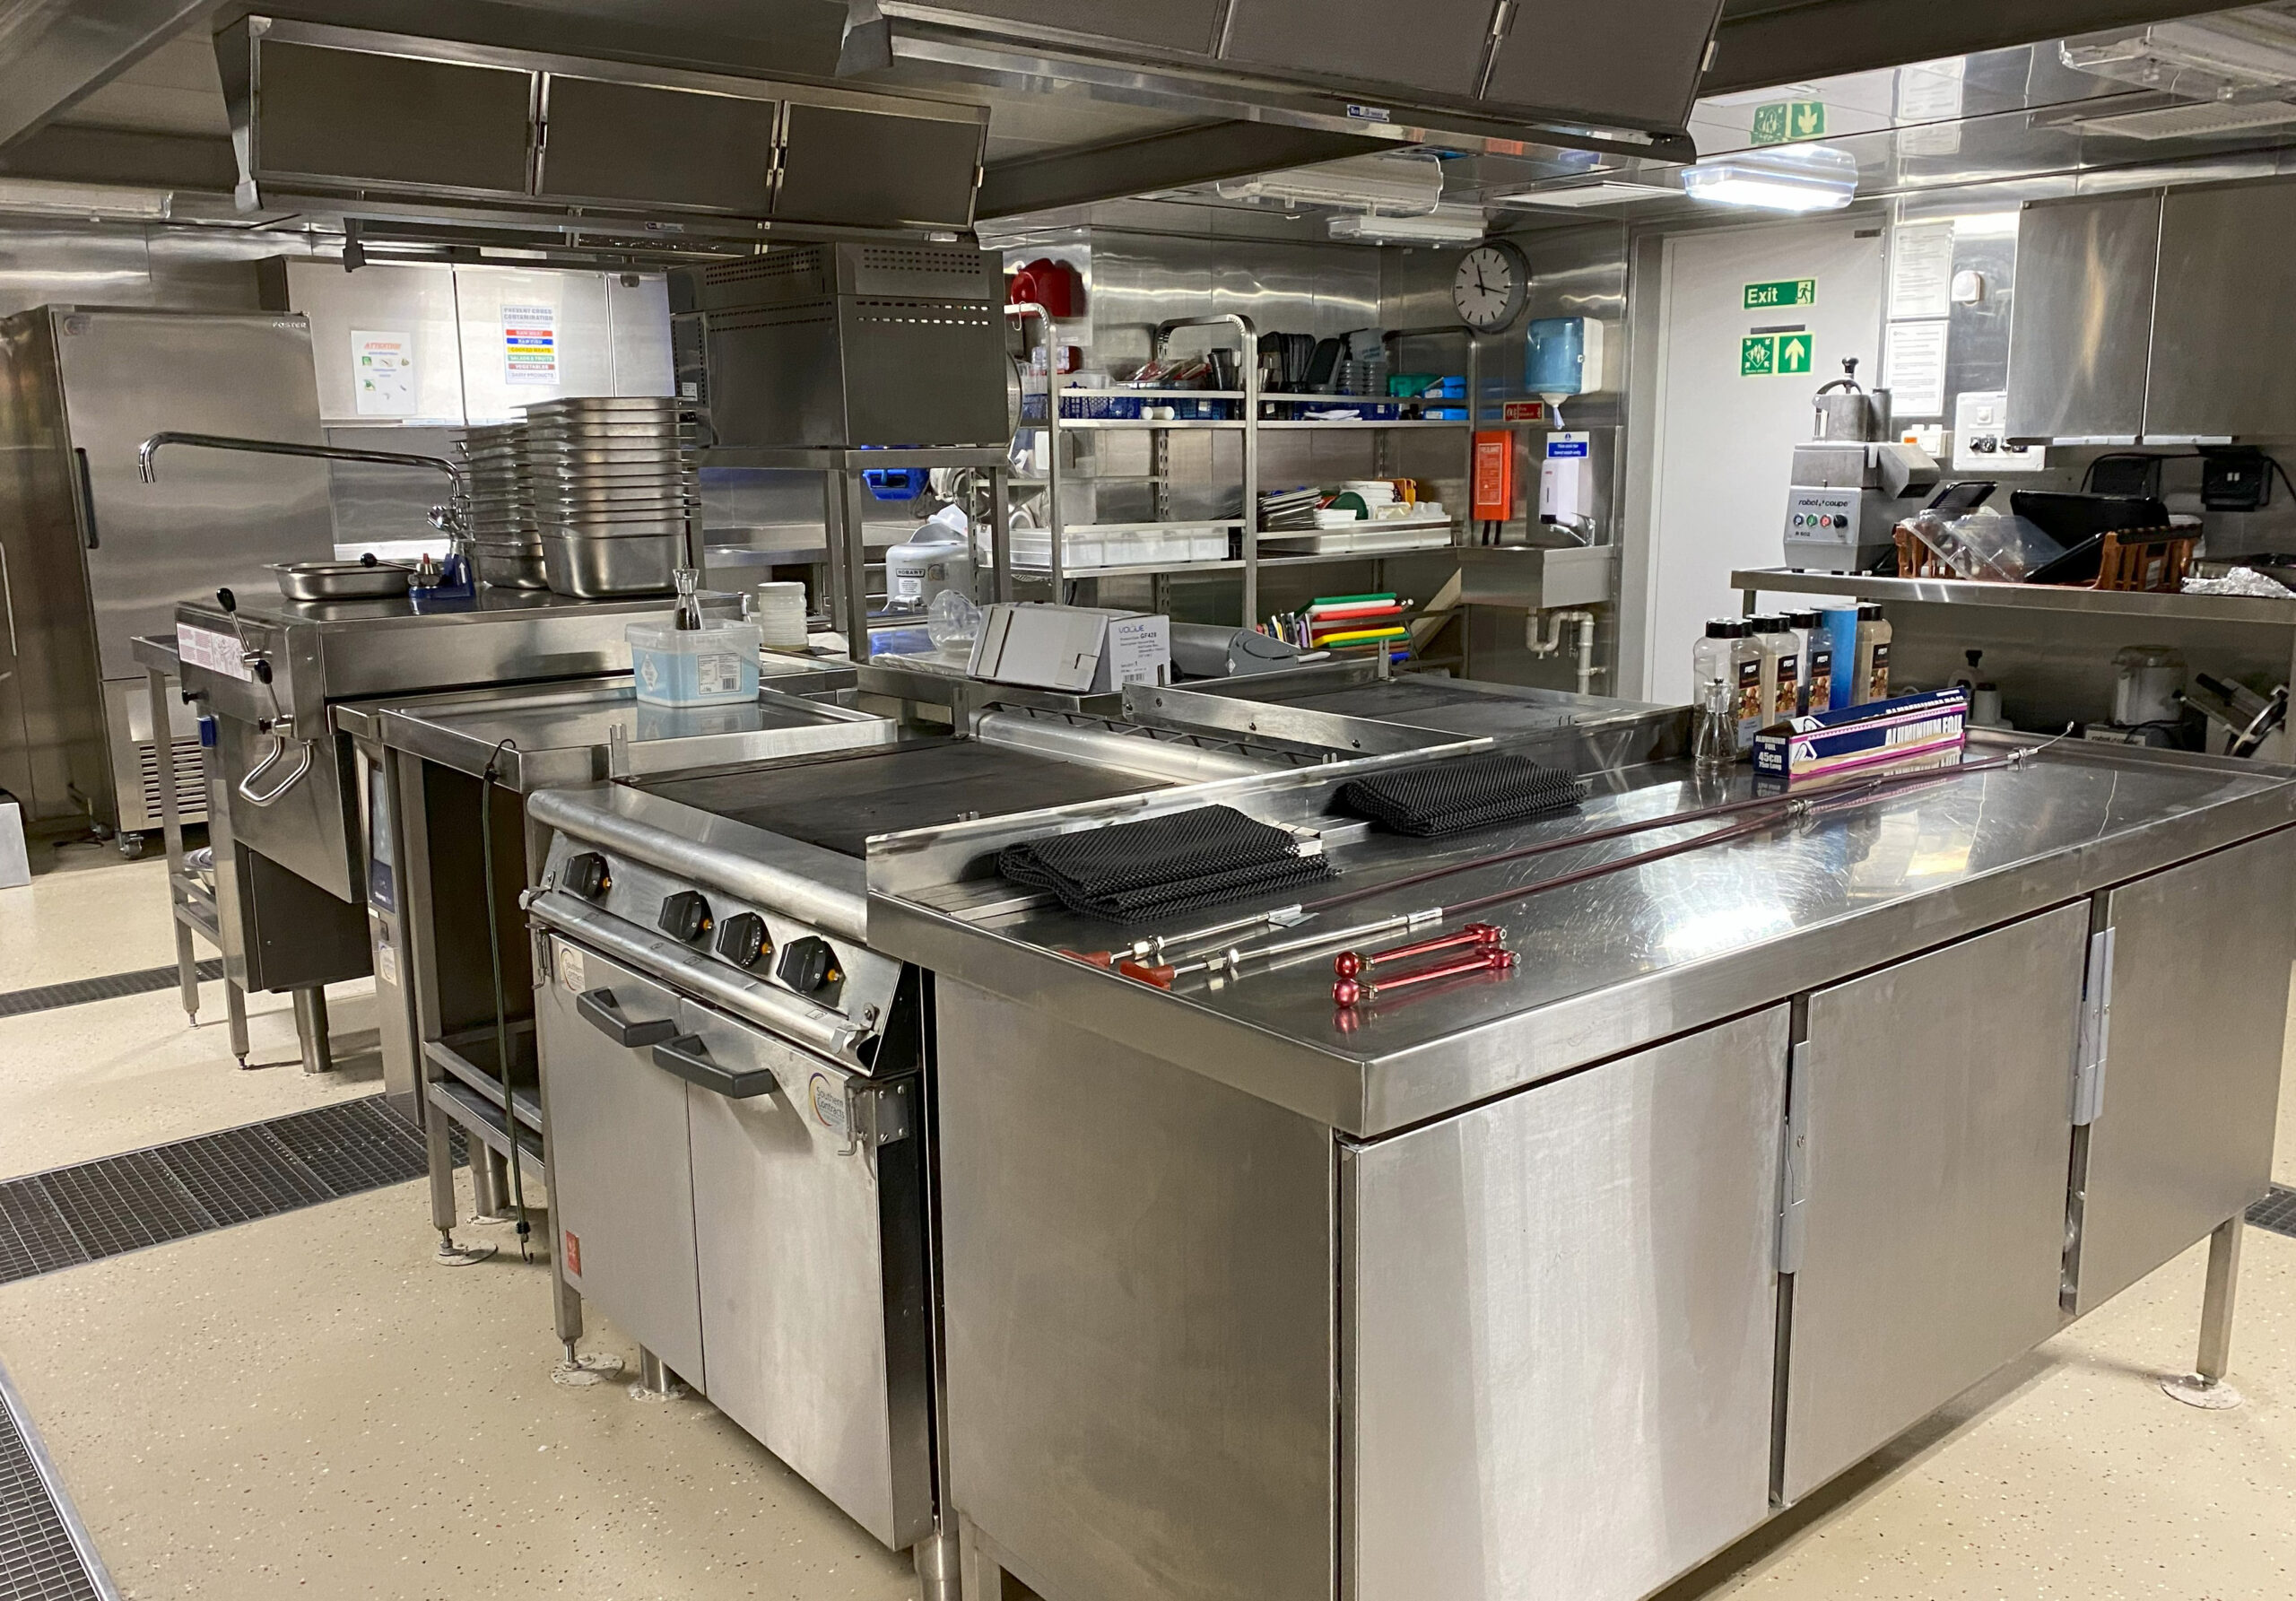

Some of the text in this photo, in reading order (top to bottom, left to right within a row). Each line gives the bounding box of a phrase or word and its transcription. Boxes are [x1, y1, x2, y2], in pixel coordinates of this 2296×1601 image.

[1747, 287, 1778, 304] Exit
[1884, 714, 1962, 746] ALUMINIUM FOIL
[1764, 743, 1776, 751] FOIL
[1758, 752, 1782, 763] 45cm
[816, 1086, 843, 1107] Southern
[817, 1097, 845, 1119] Contracts
